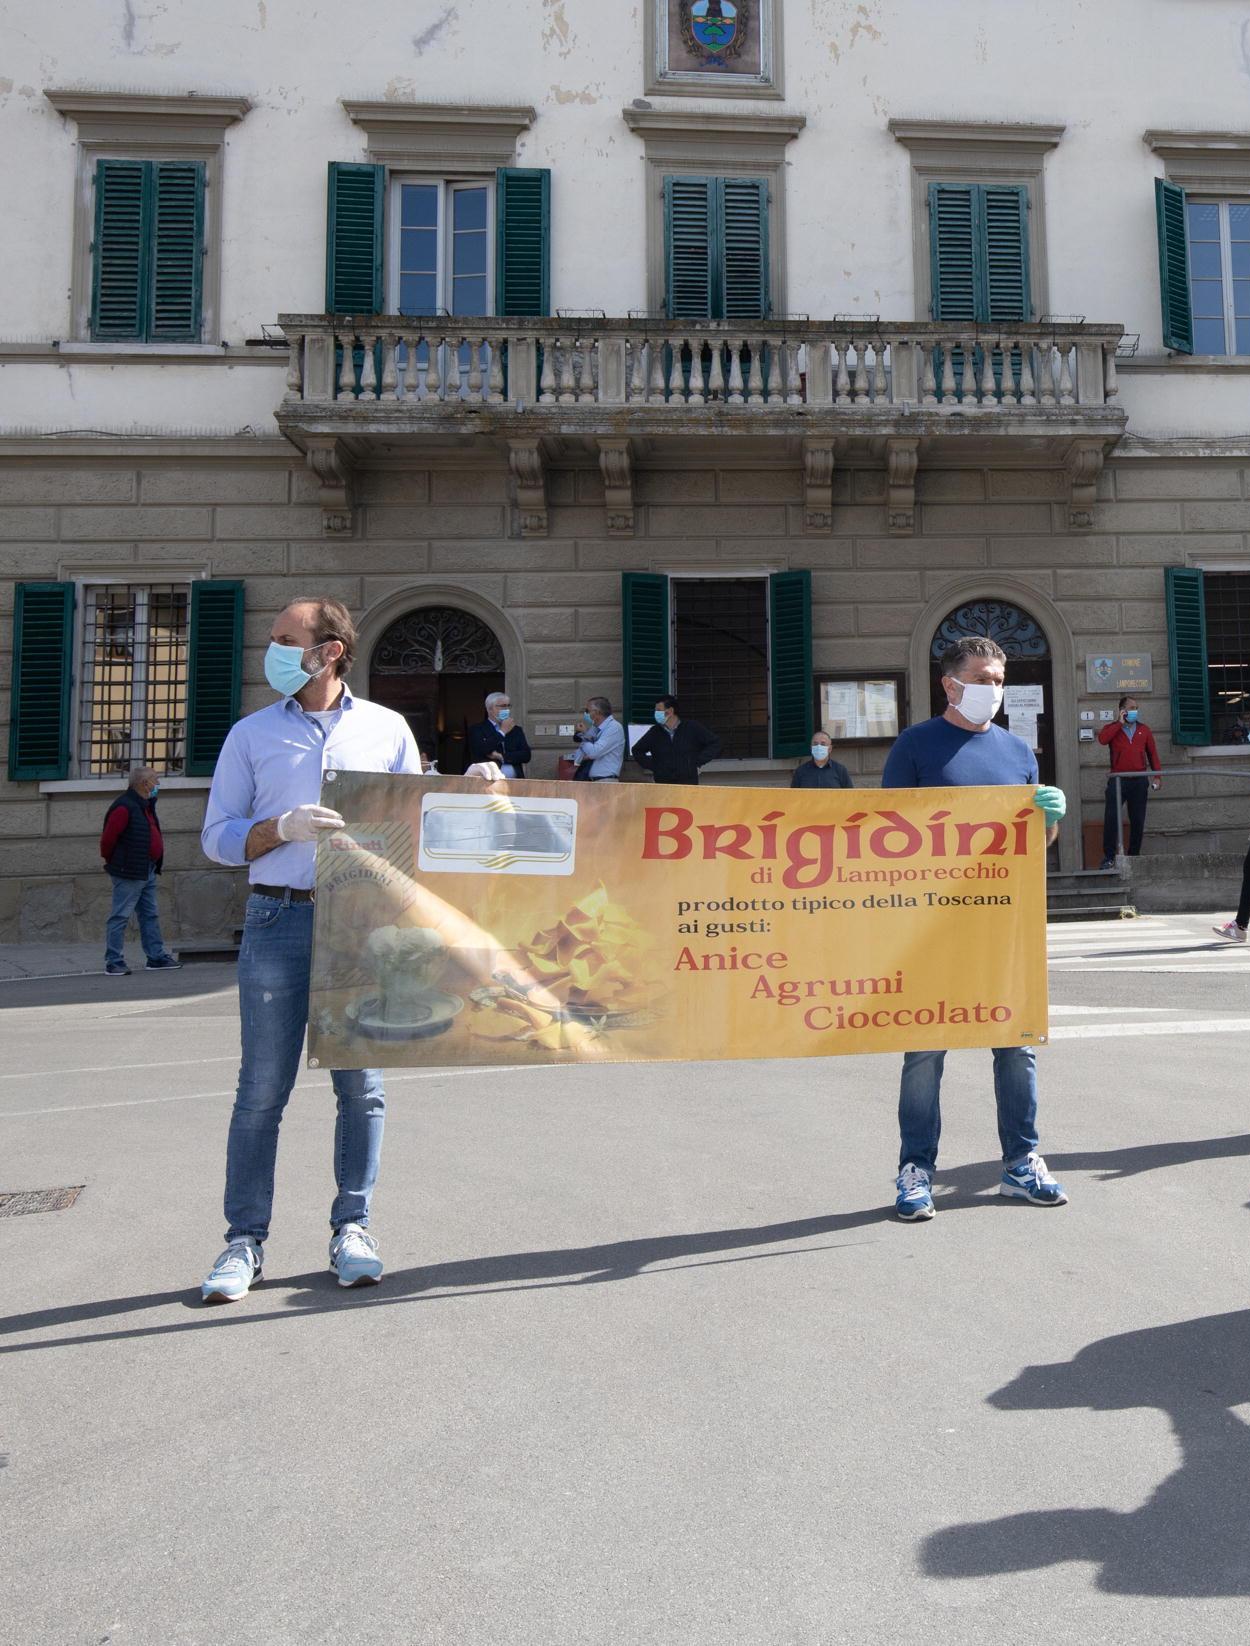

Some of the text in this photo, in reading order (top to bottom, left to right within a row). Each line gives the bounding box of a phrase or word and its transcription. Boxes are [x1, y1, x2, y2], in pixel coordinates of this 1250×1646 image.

[641, 807, 1034, 889] Brigidini
[751, 861, 1009, 887] di Lamporecchio
[677, 892, 1012, 916] prodotto tipico della Toscana
[678, 918, 771, 938] ai gusti:
[673, 946, 789, 971] Anice
[750, 970, 904, 1006] Agrumi
[803, 1000, 1012, 1031] Cioccolato
